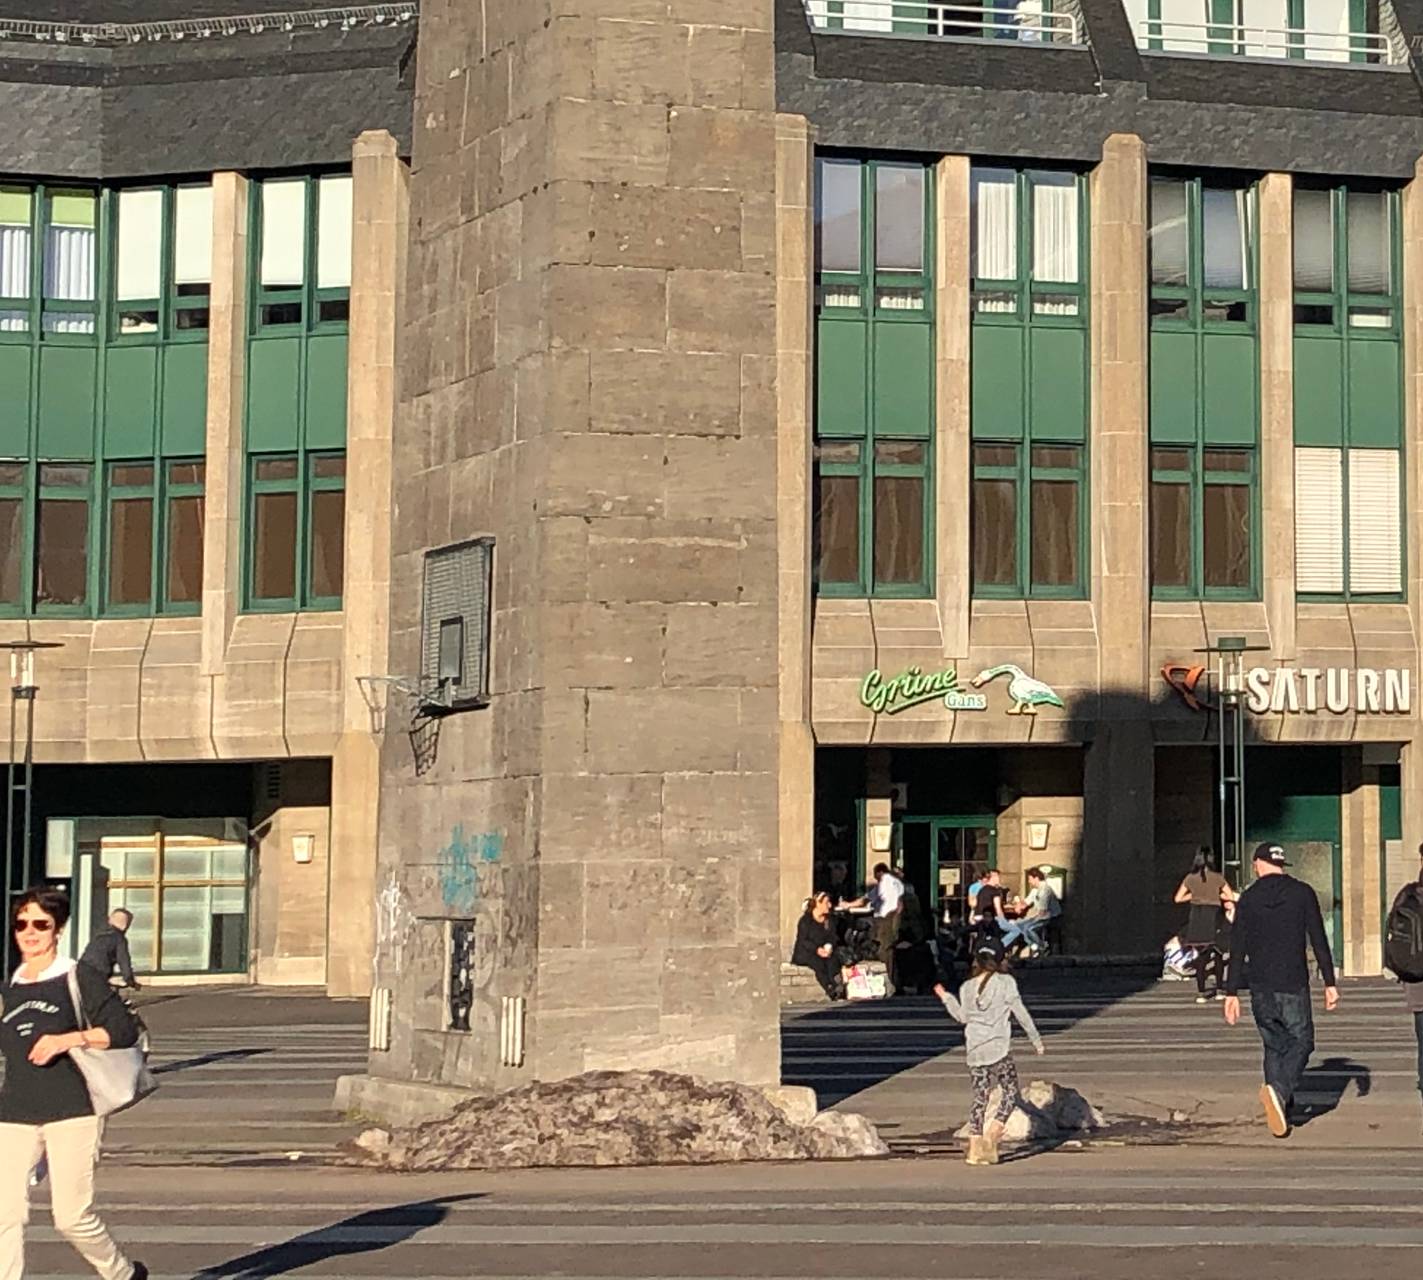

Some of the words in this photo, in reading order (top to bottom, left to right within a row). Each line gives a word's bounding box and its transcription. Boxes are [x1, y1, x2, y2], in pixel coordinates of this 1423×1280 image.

[861, 664, 959, 713] Grüne
[948, 692, 985, 708] Gans
[1248, 667, 1411, 714] SATURN
